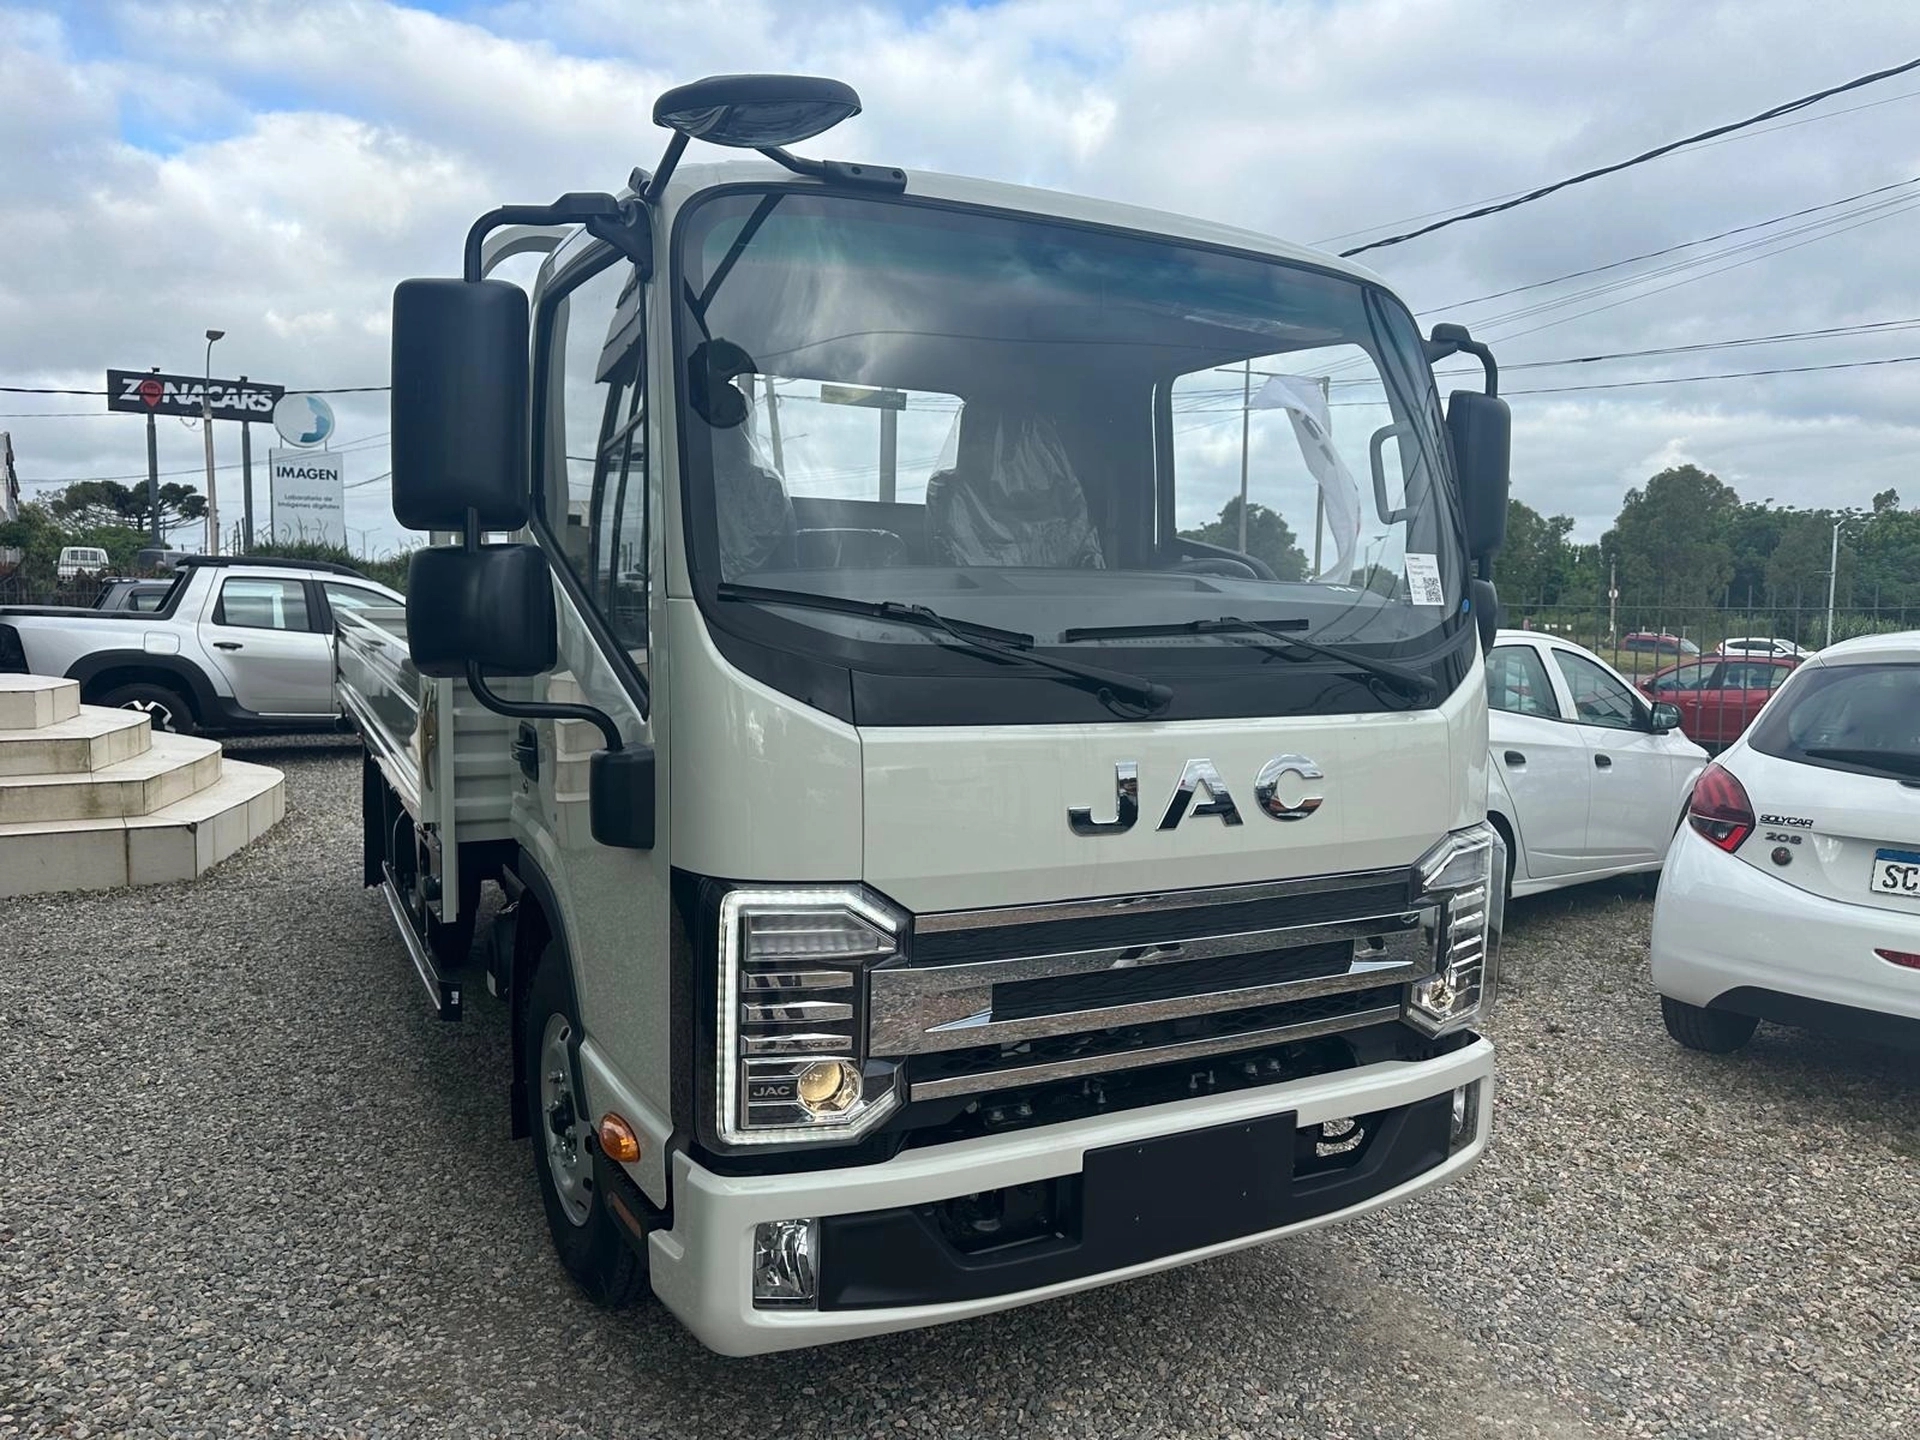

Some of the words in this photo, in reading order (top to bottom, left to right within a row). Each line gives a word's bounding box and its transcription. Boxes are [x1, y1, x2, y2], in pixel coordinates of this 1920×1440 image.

[276, 465, 338, 480] IMAGEN
[1067, 753, 1324, 837] JAC
[1760, 814, 1814, 827] SOLYCAR
[1765, 832, 1802, 845] 208
[753, 1085, 791, 1096] JAC
